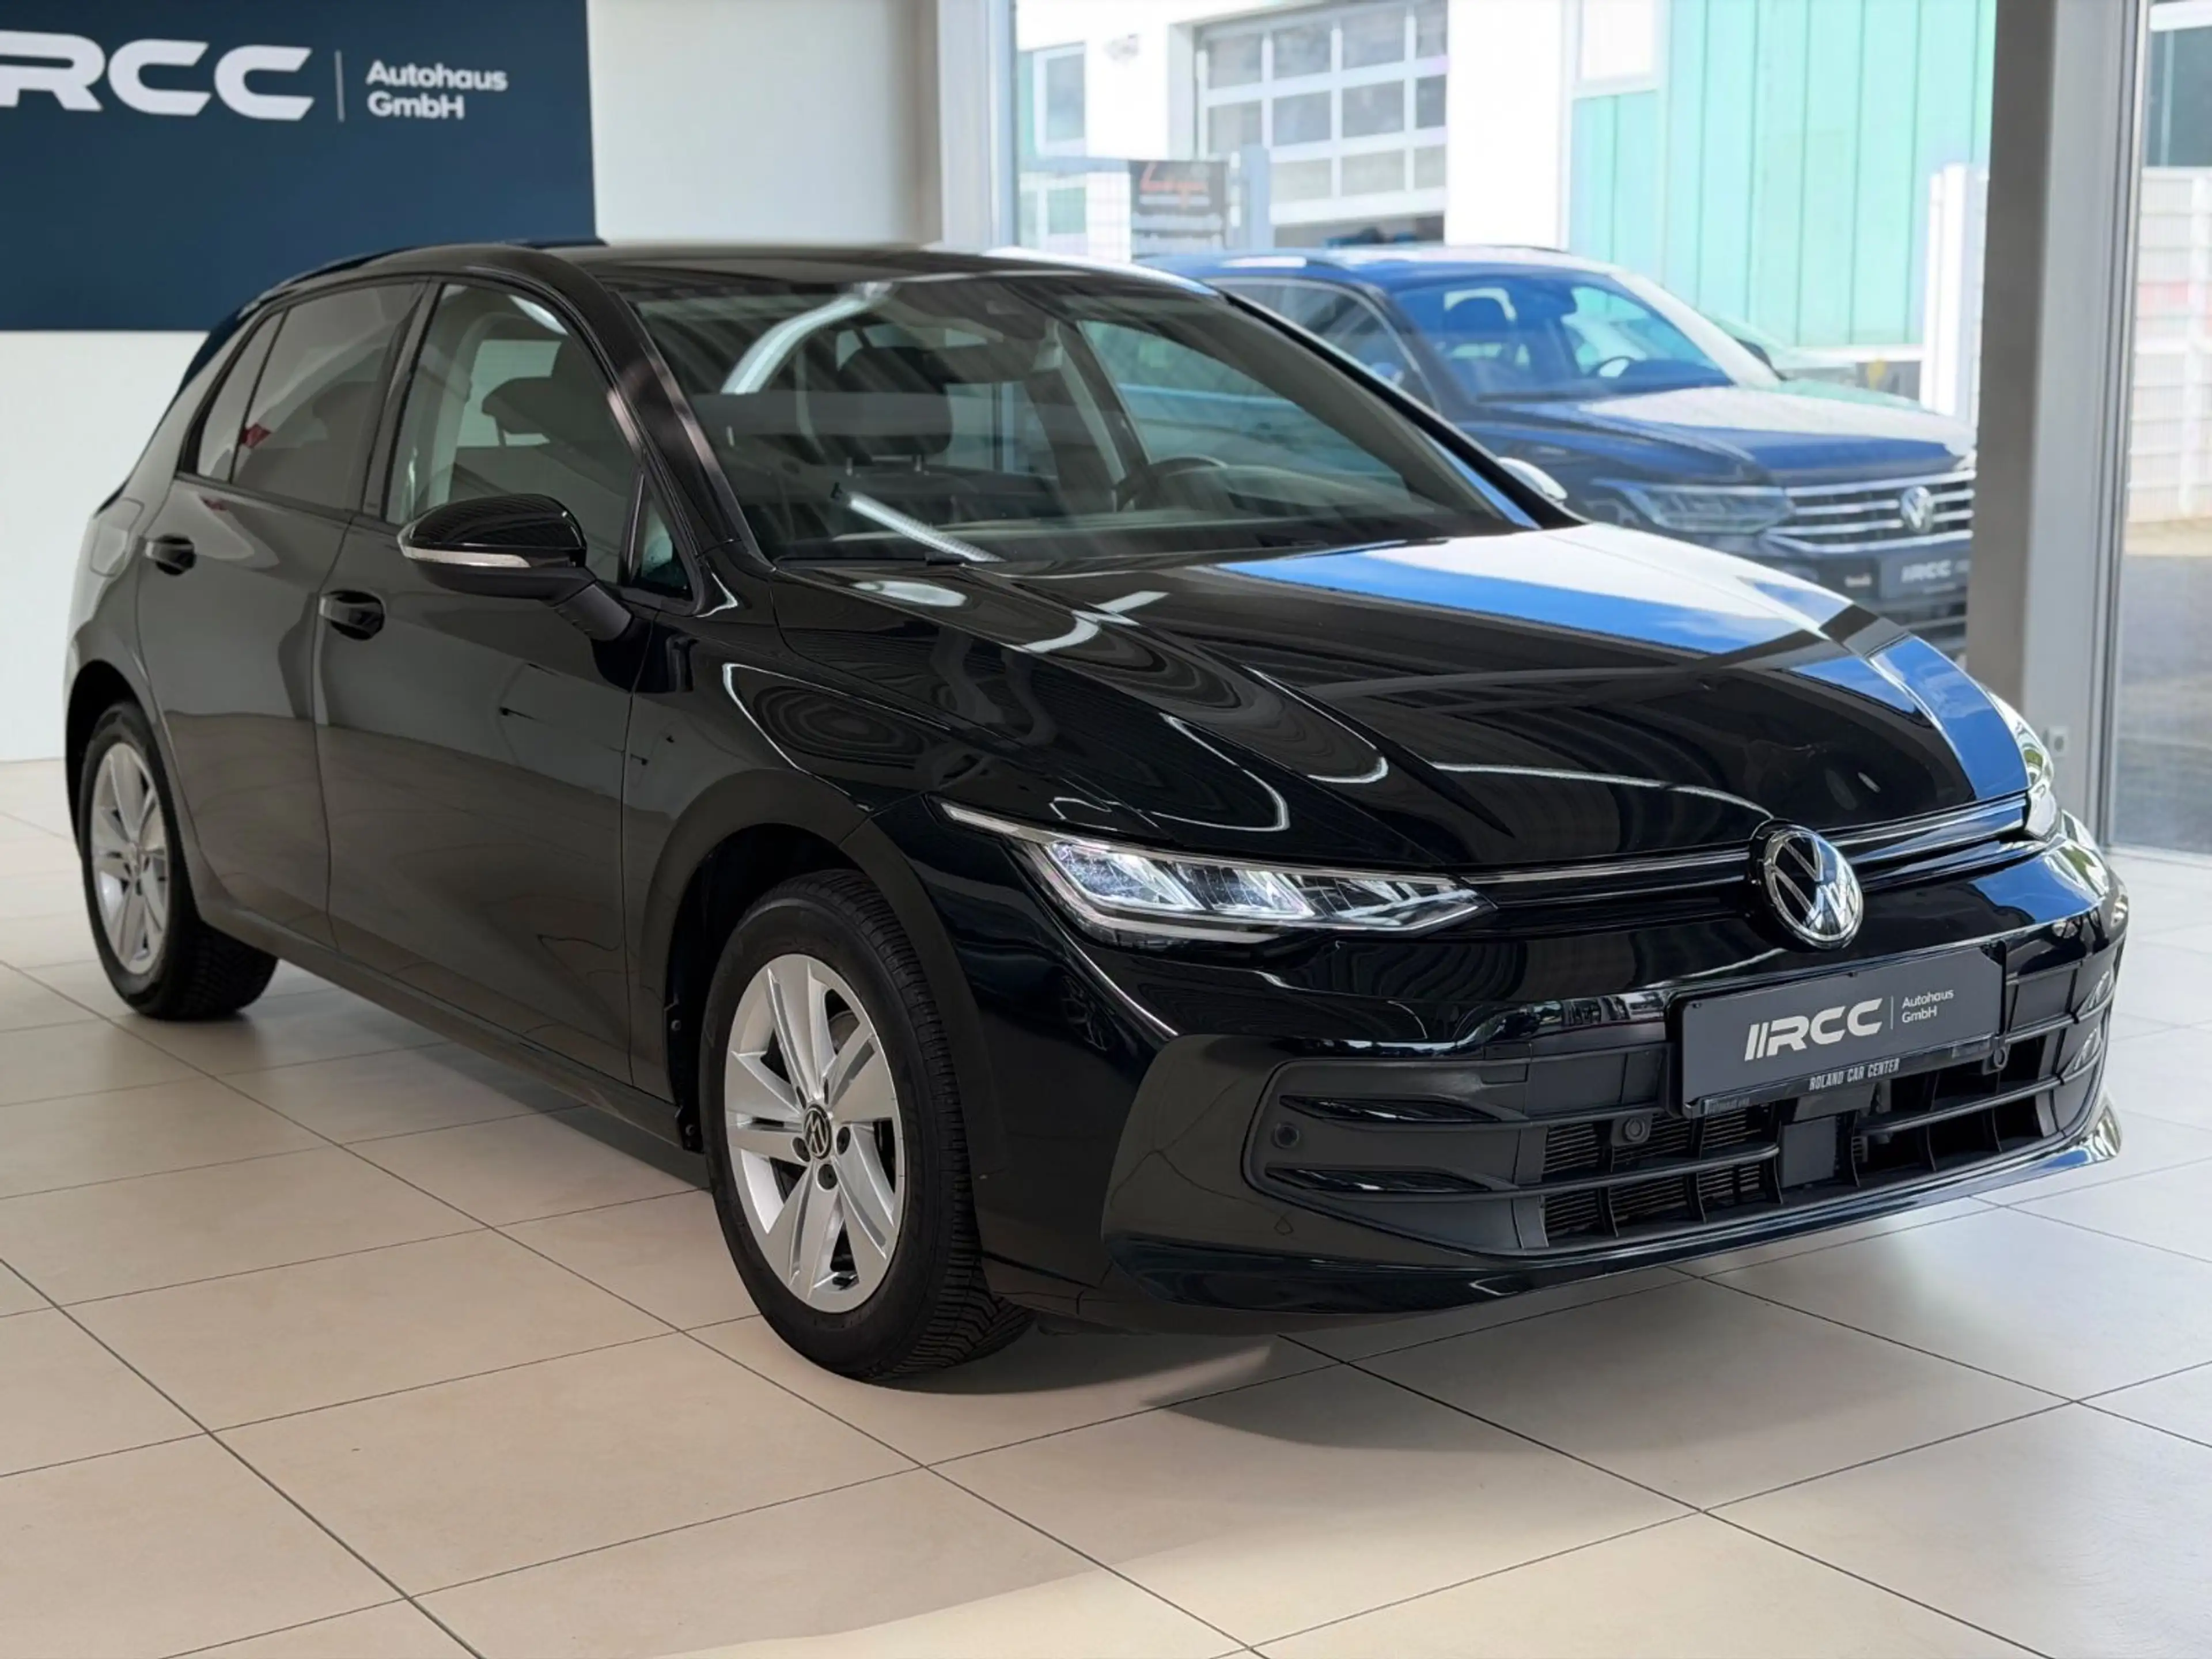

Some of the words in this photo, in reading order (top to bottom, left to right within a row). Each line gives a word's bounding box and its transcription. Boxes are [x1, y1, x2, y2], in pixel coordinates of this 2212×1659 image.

[366, 60, 507, 91] Autohaus
[367, 92, 464, 119] GmbH
[1902, 988, 1955, 1009] Autohaus
[1902, 1005, 1937, 1023] GmbH
[1809, 1071, 1844, 1090] ROLAND
[1847, 1066, 1865, 1082] CAR
[1868, 1058, 1900, 1078] CENTER
